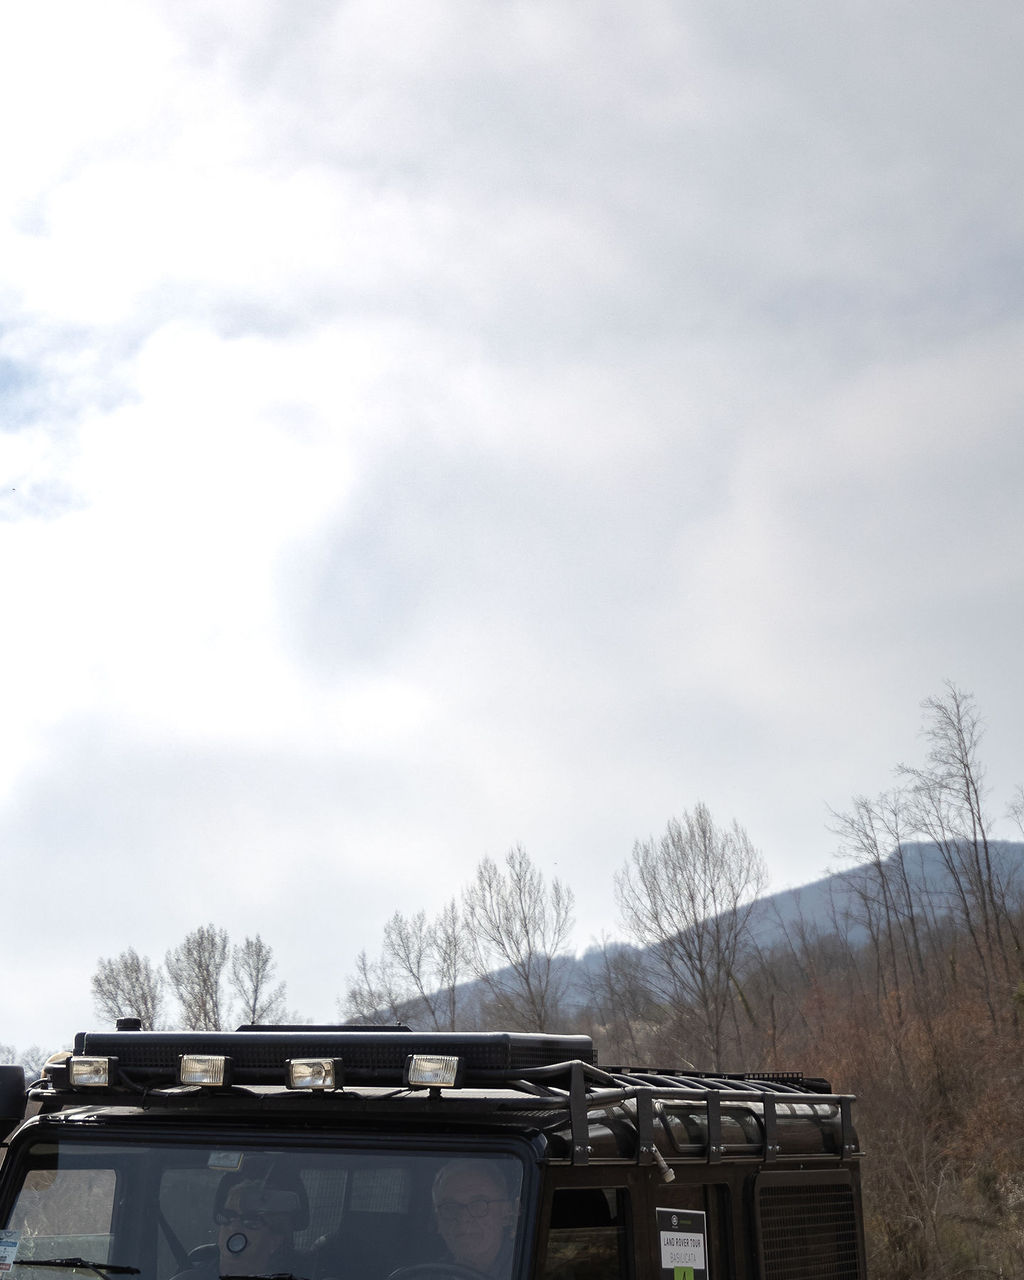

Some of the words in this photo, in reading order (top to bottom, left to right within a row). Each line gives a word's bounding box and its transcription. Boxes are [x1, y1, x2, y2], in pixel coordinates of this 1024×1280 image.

[664, 1237, 675, 1247] LAND
[675, 1238, 690, 1248] ROVER
[690, 1239, 702, 1248] TOUR
